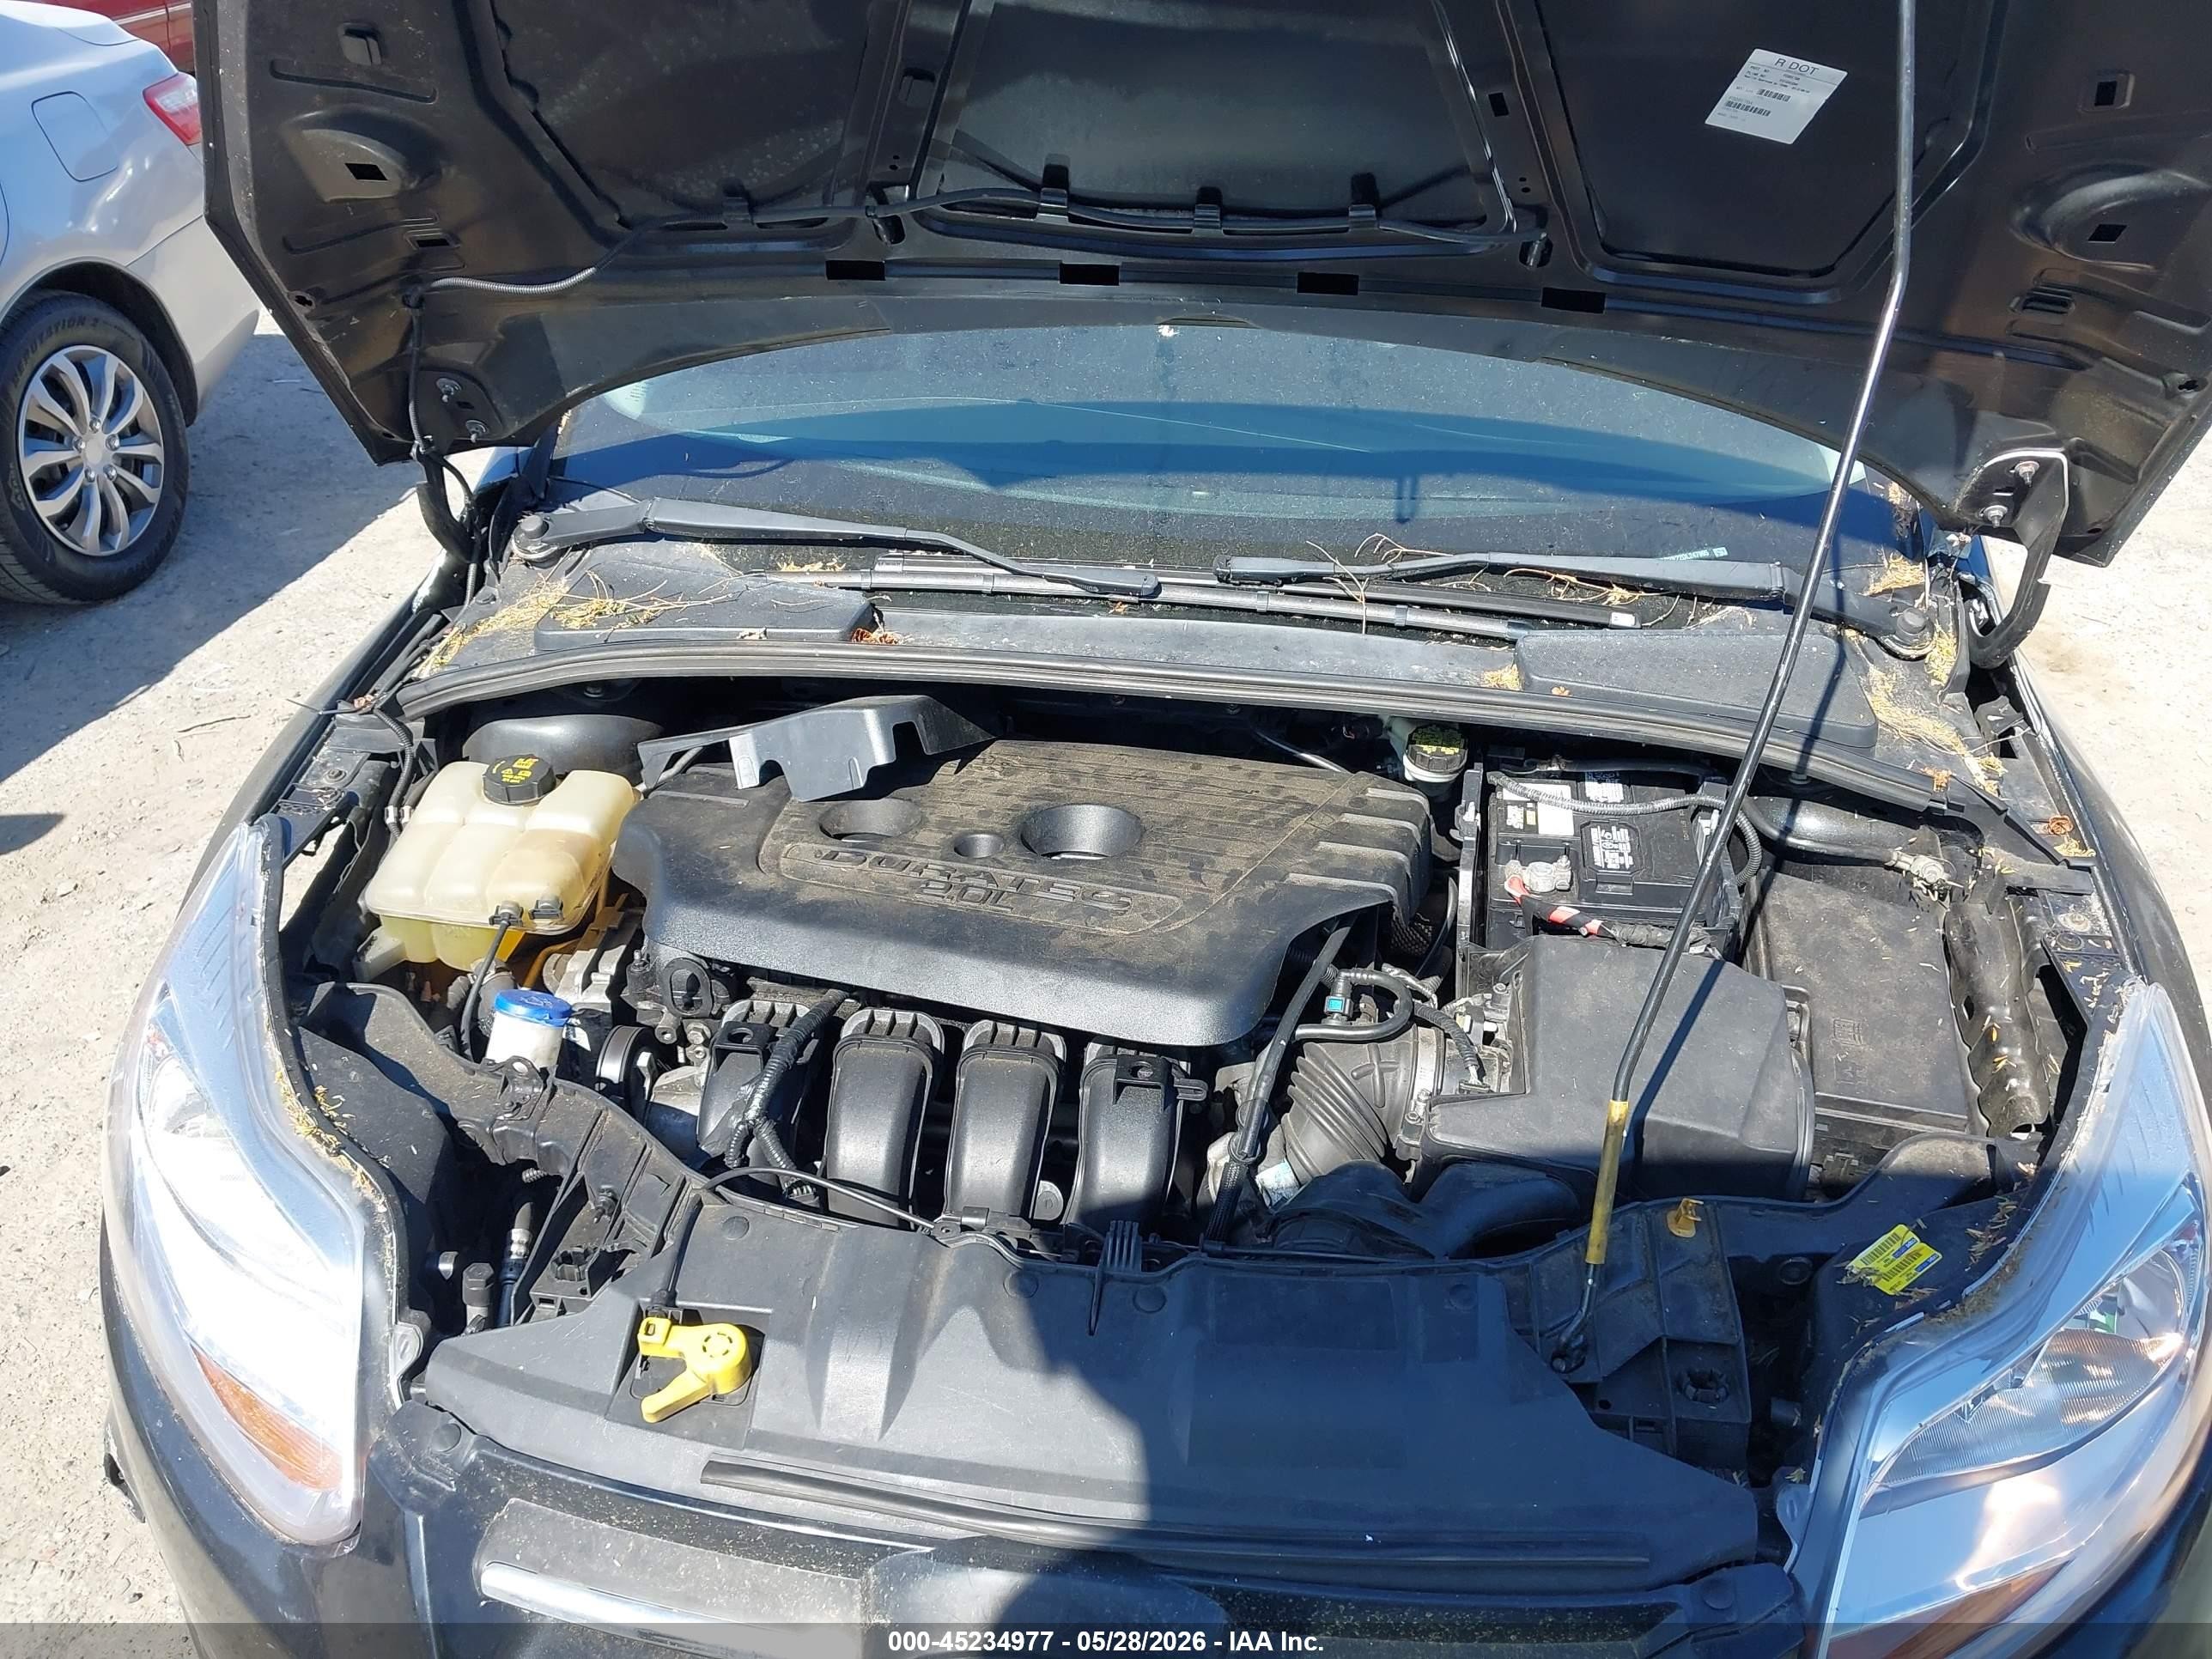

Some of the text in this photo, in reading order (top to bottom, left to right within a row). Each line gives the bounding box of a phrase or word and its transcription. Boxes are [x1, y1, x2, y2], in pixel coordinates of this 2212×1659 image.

[1774, 58, 1820, 76] R DOT
[818, 850, 1133, 911] DURATEC
